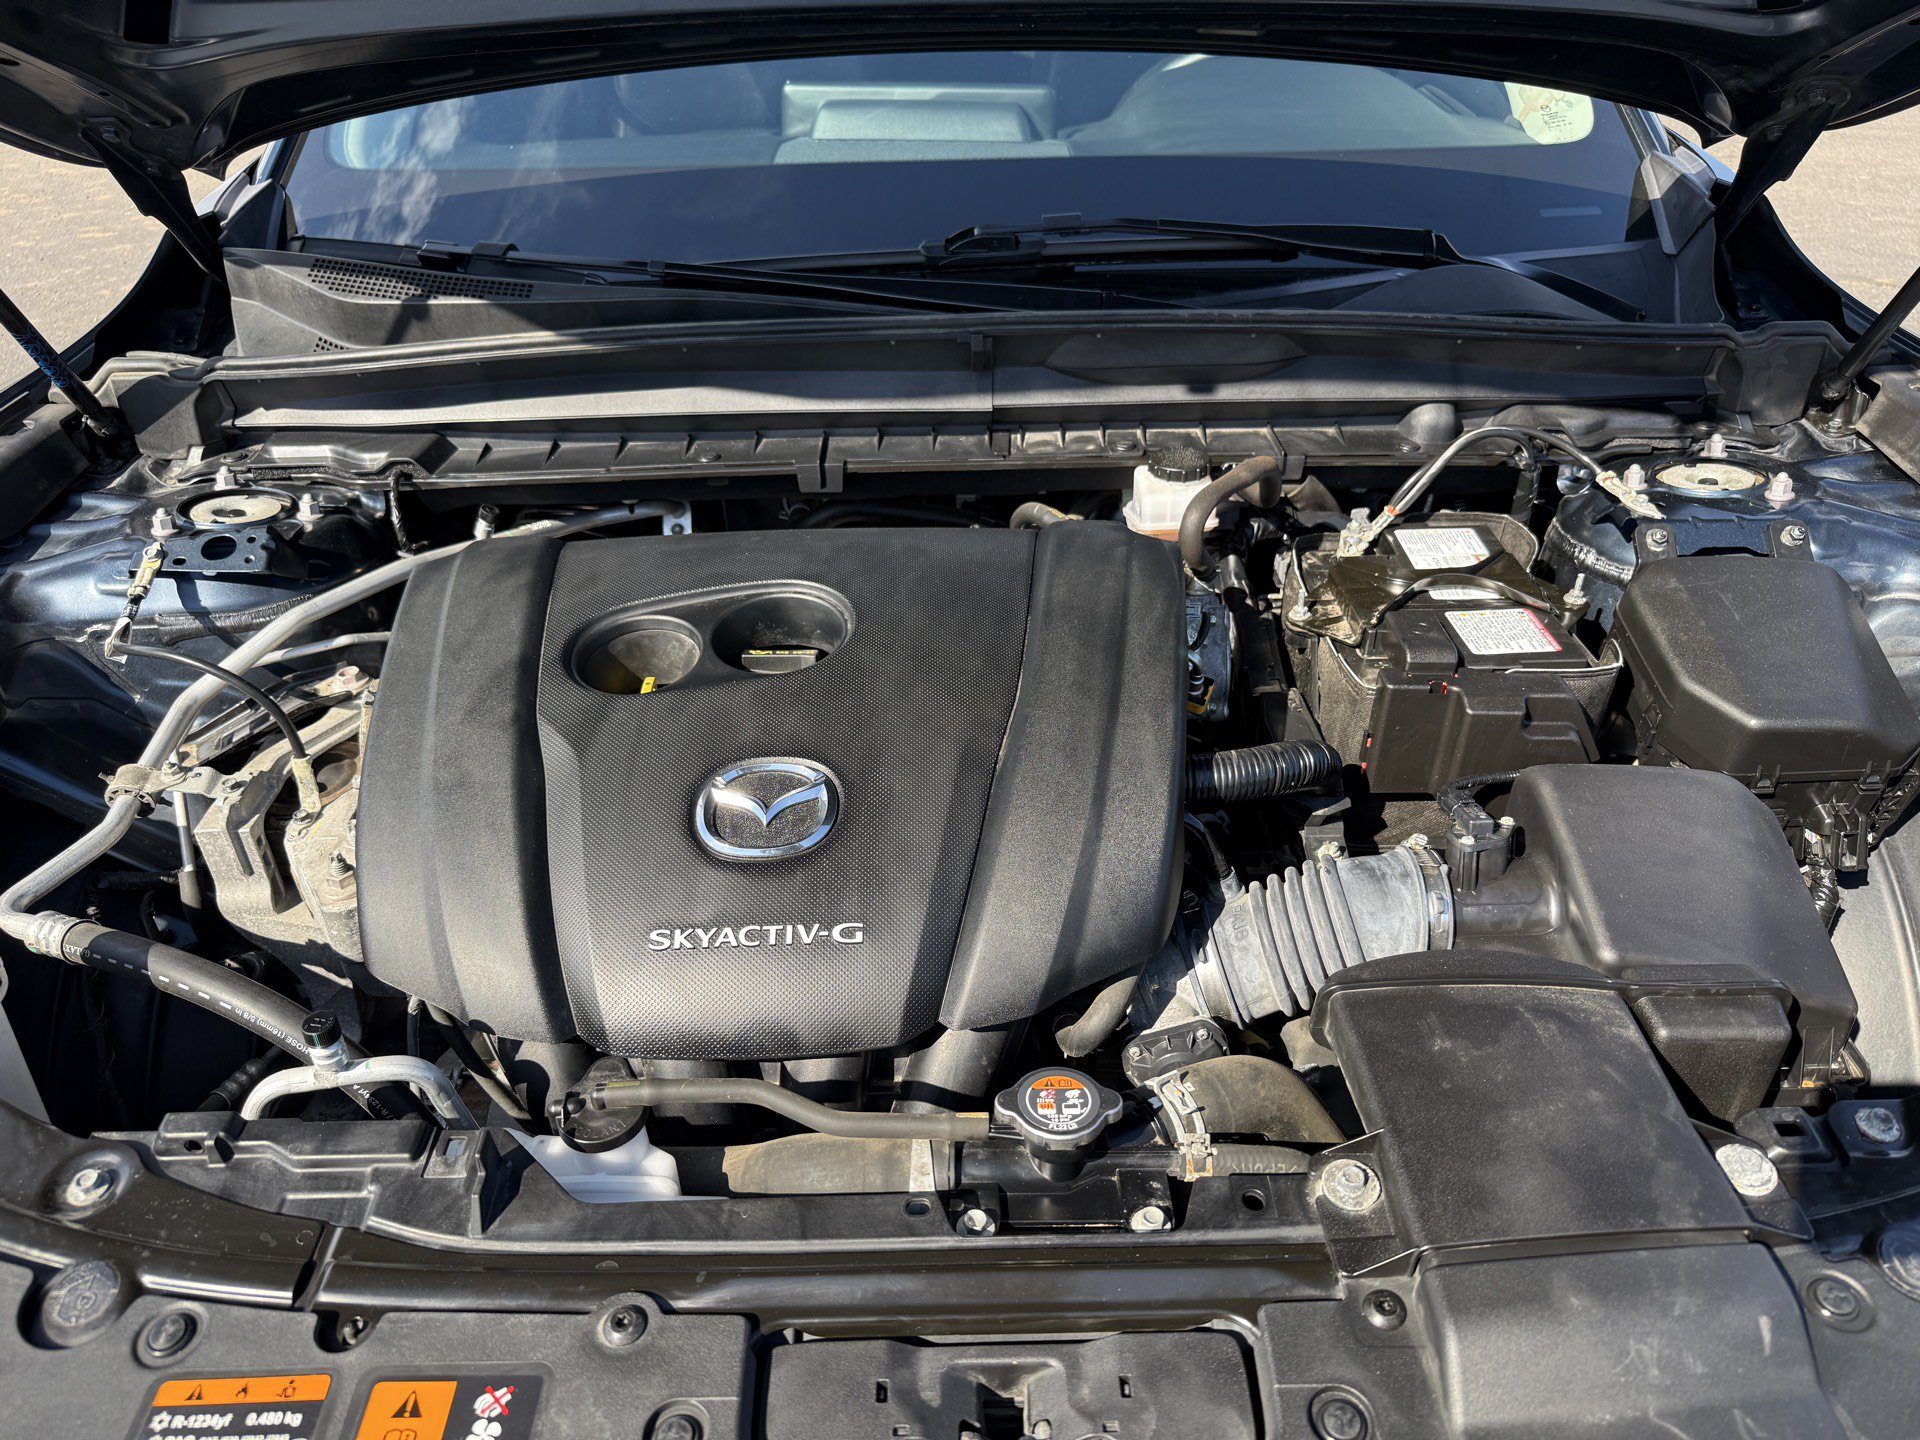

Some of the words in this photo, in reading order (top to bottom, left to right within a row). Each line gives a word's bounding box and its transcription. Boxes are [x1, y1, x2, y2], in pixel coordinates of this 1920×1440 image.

[648, 922, 864, 951] SKYACTIV-G
[285, 1034, 311, 1055] HOSE
[574, 1120, 627, 1138] OOLANT
[283, 1411, 303, 1428] kg
